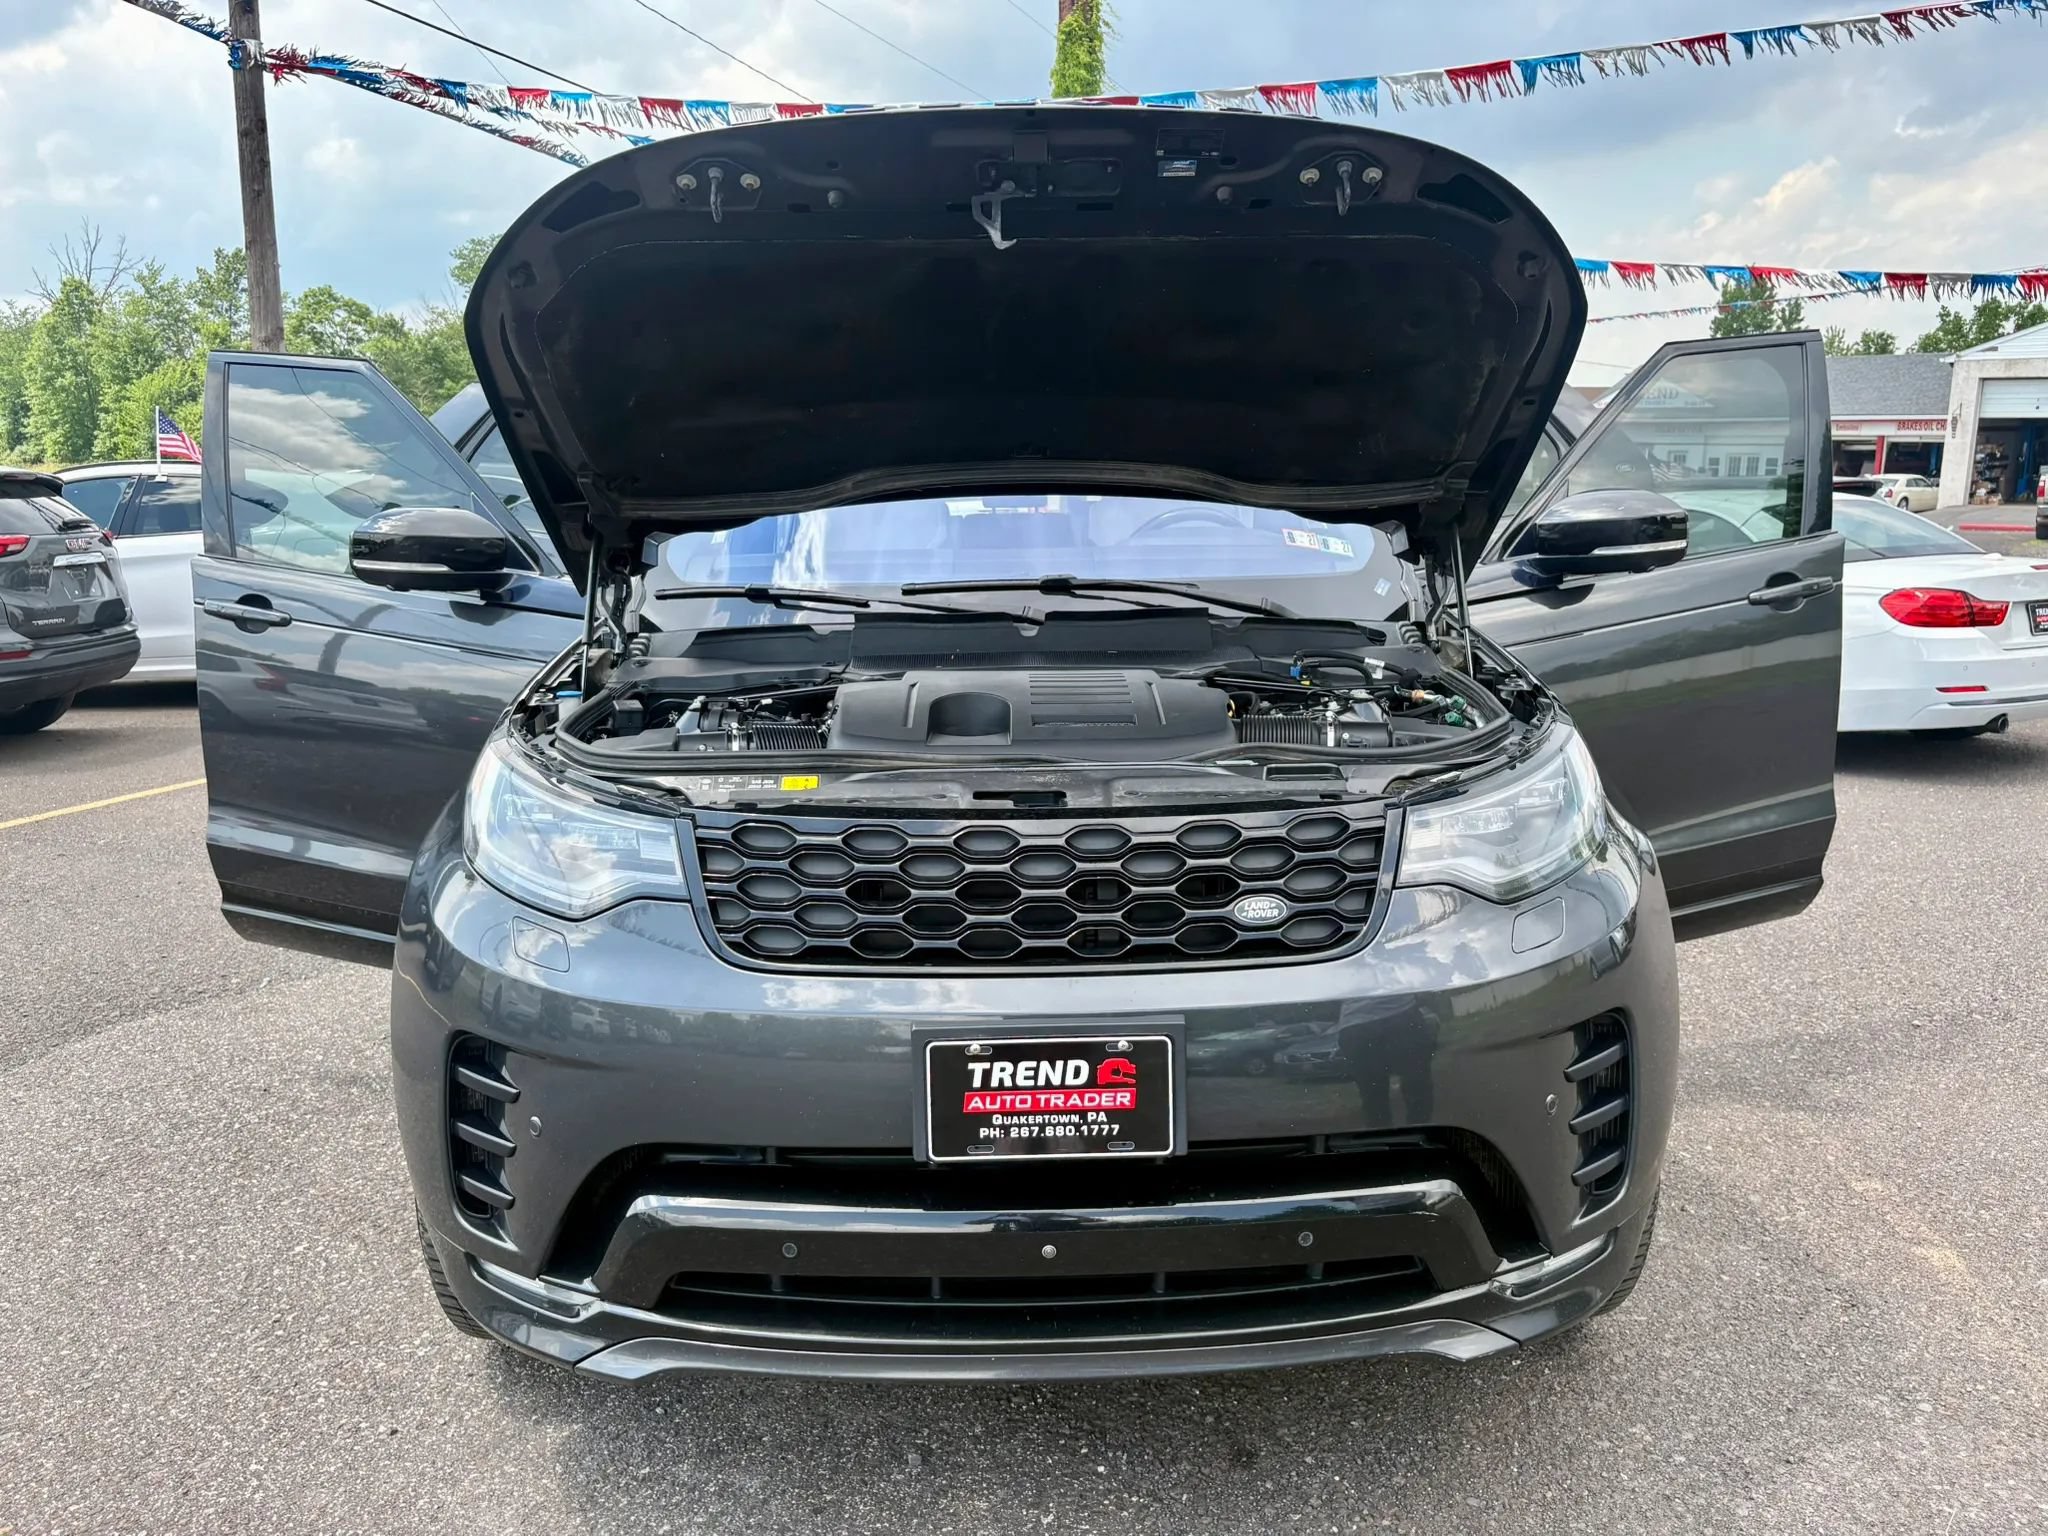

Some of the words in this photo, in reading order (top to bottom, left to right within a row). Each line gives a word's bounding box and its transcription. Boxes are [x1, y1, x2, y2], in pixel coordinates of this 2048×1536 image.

[1897, 420, 1923, 431] BRAKES
[1923, 420, 1934, 431] OIL
[32, 617, 66, 626] TERRAIN
[1244, 901, 1270, 910] LAND
[1247, 909, 1279, 919] ROVER
[967, 1059, 1089, 1088] TREND
[967, 1094, 1031, 1110] AUTO
[1036, 1091, 1131, 1107] TRADER
[1088, 1112, 1108, 1123] PA
[980, 1127, 1004, 1139] PH:
[1010, 1124, 1120, 1138] 267.680.1777
